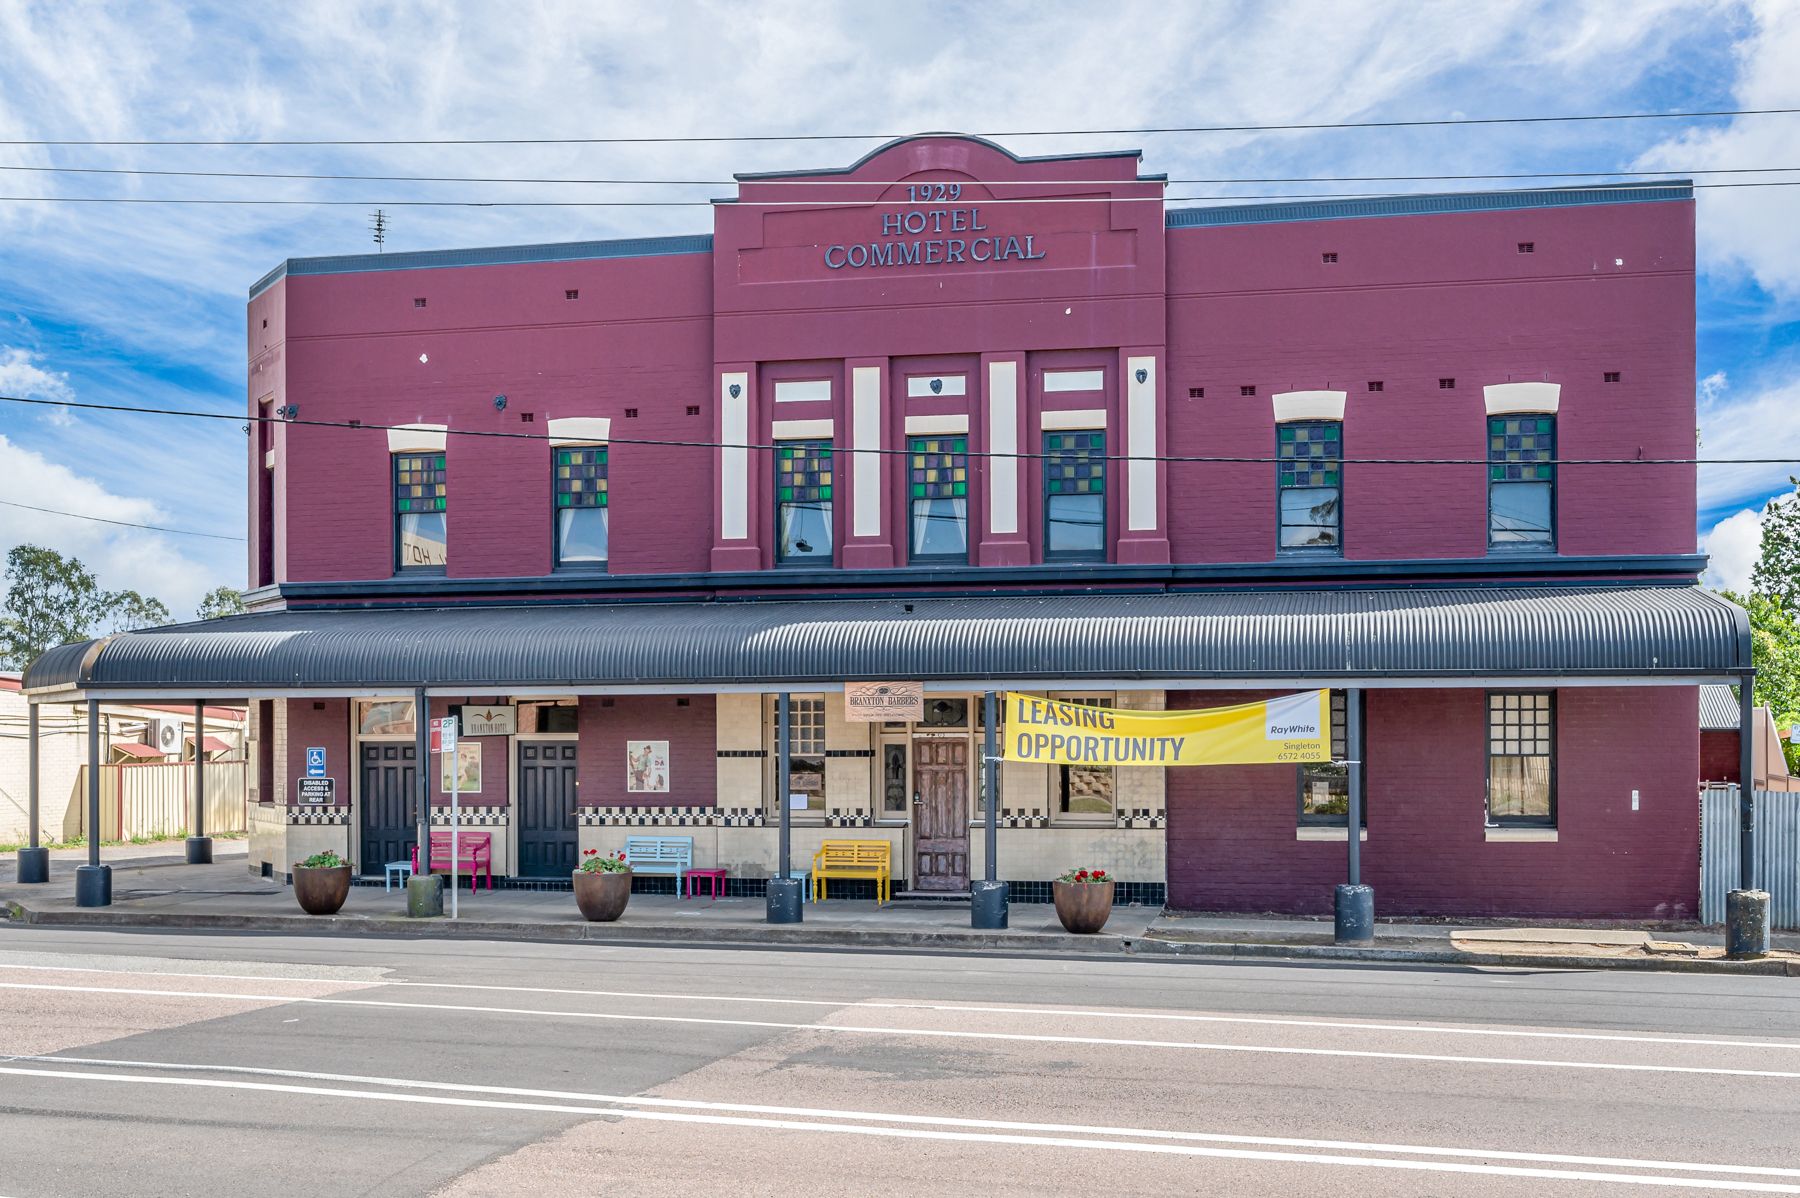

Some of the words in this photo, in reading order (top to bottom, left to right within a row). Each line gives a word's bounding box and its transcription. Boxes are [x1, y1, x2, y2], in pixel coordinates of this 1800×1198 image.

[906, 183, 962, 204] 1929
[881, 208, 988, 237] HOTEL
[824, 234, 1047, 270] COMMERCIAL
[849, 696, 885, 706] BRANXTON
[888, 695, 919, 706] BARBERS
[442, 718, 454, 728] 2P
[1017, 698, 1115, 730] LEASING
[1016, 732, 1185, 763] OPPORTUNITY
[1277, 752, 1298, 760] 6572
[1300, 752, 1321, 760] 4055
[1283, 742, 1321, 751] Singleton
